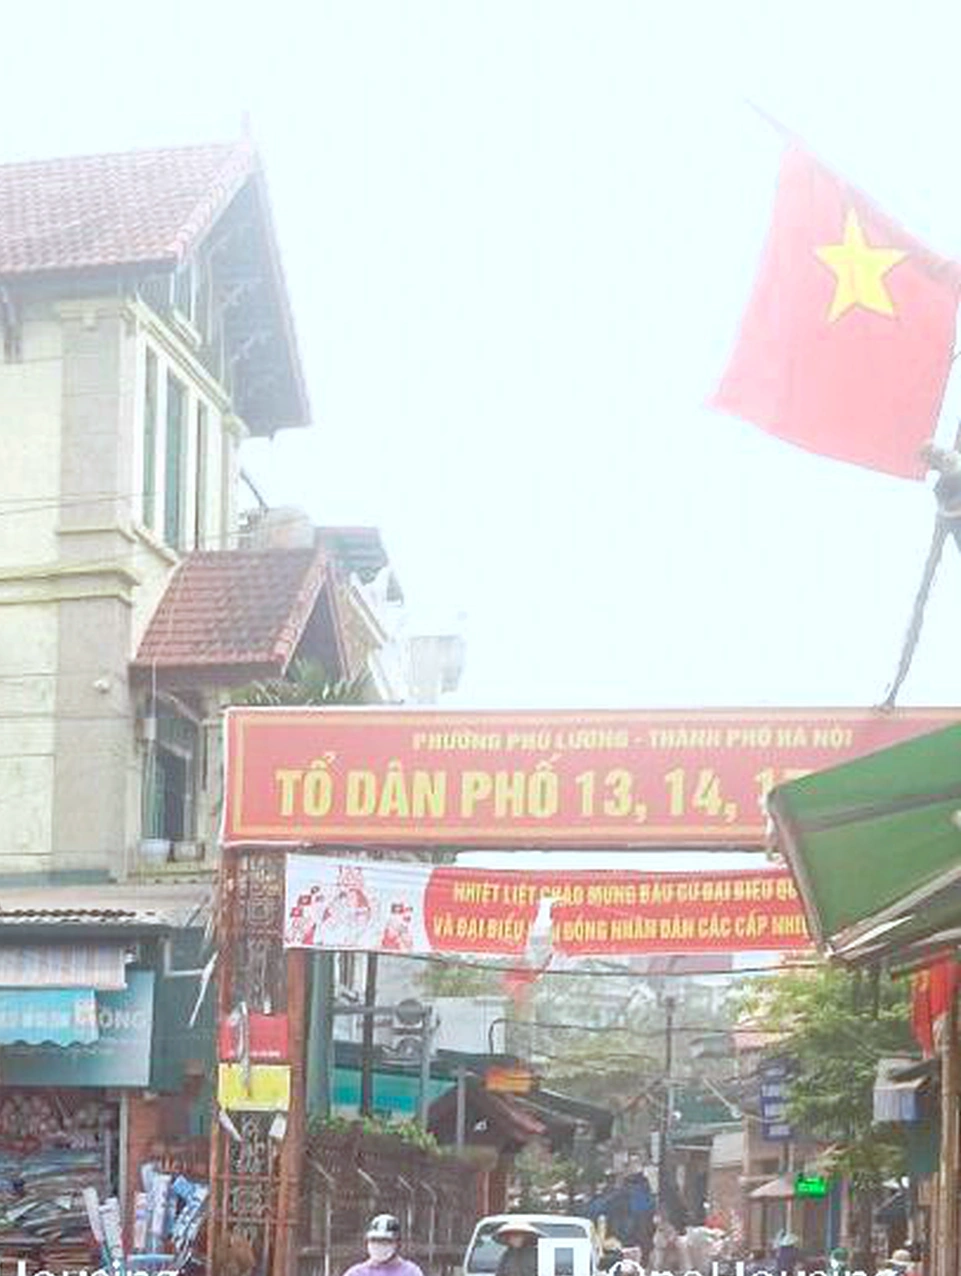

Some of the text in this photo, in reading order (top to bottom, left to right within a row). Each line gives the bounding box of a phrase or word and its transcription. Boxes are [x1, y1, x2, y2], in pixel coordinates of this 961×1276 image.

[275, 751, 336, 817] TỔ
[345, 758, 447, 818] DÂN
[460, 751, 562, 818] PHỐ
[575, 769, 647, 823] 13,
[664, 767, 737, 823] 14,
